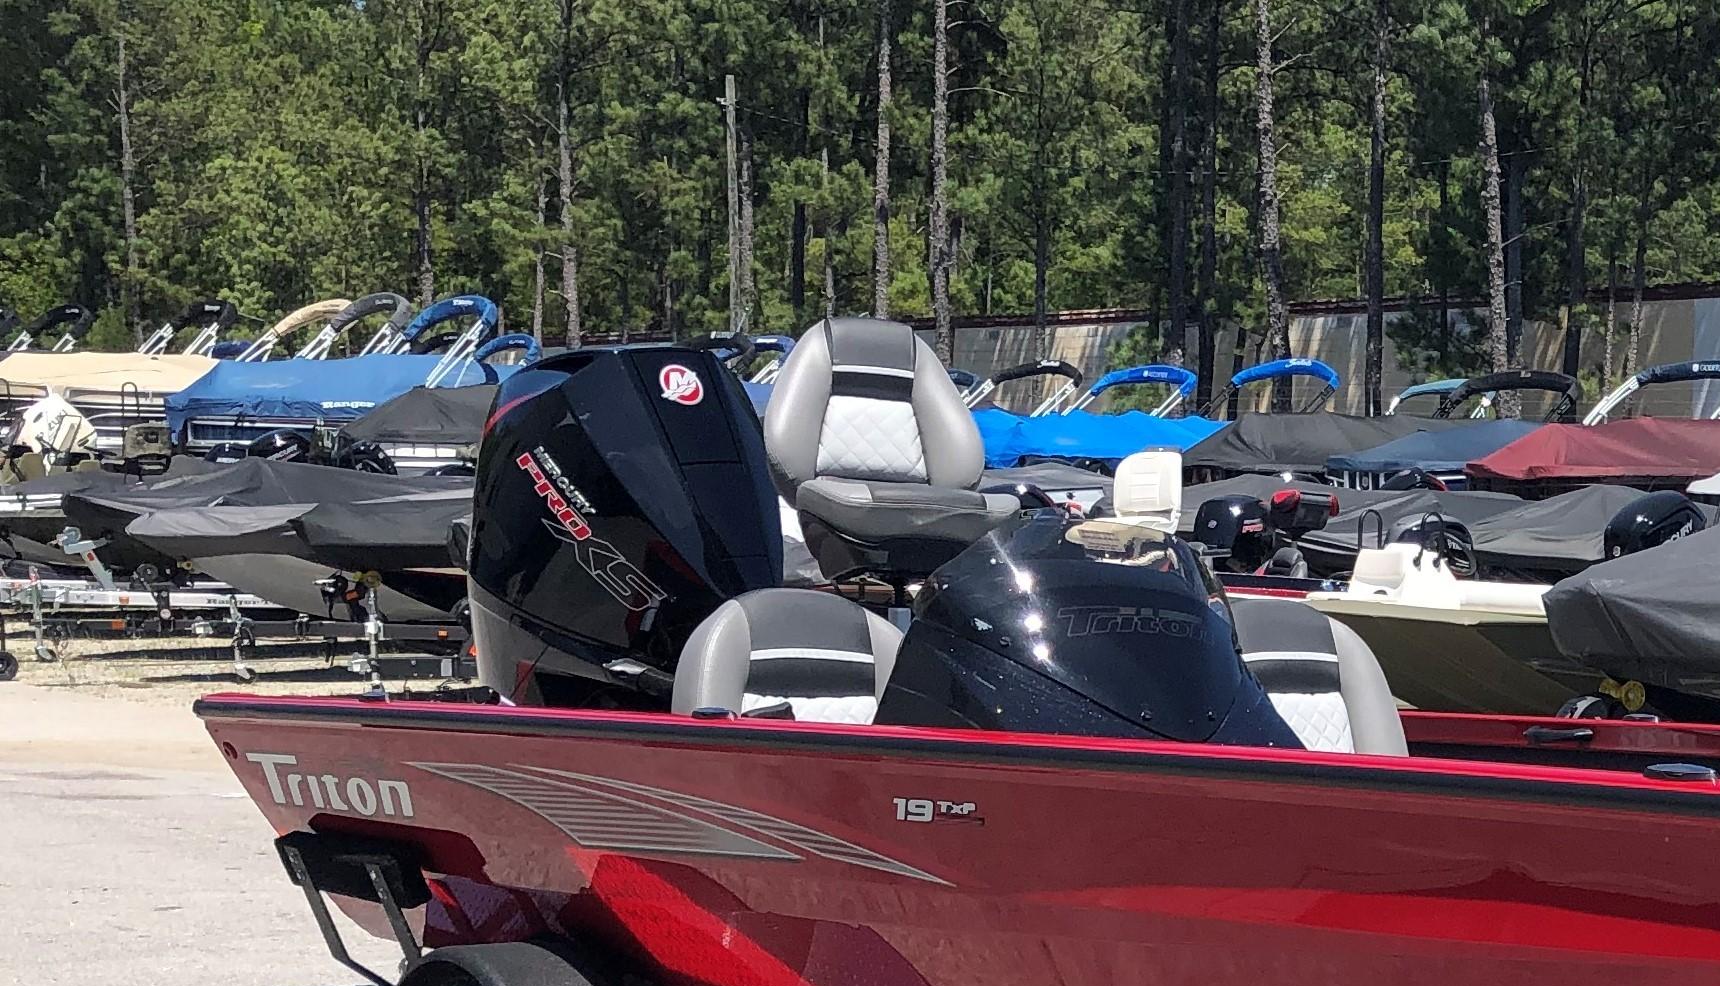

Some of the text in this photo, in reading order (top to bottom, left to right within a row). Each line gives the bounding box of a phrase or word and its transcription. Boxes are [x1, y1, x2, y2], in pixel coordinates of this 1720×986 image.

[515, 451, 592, 540] PRO
[533, 445, 597, 514] MERCURY
[541, 517, 667, 611] XS
[245, 752, 414, 817] Triton
[893, 797, 934, 822] 19
